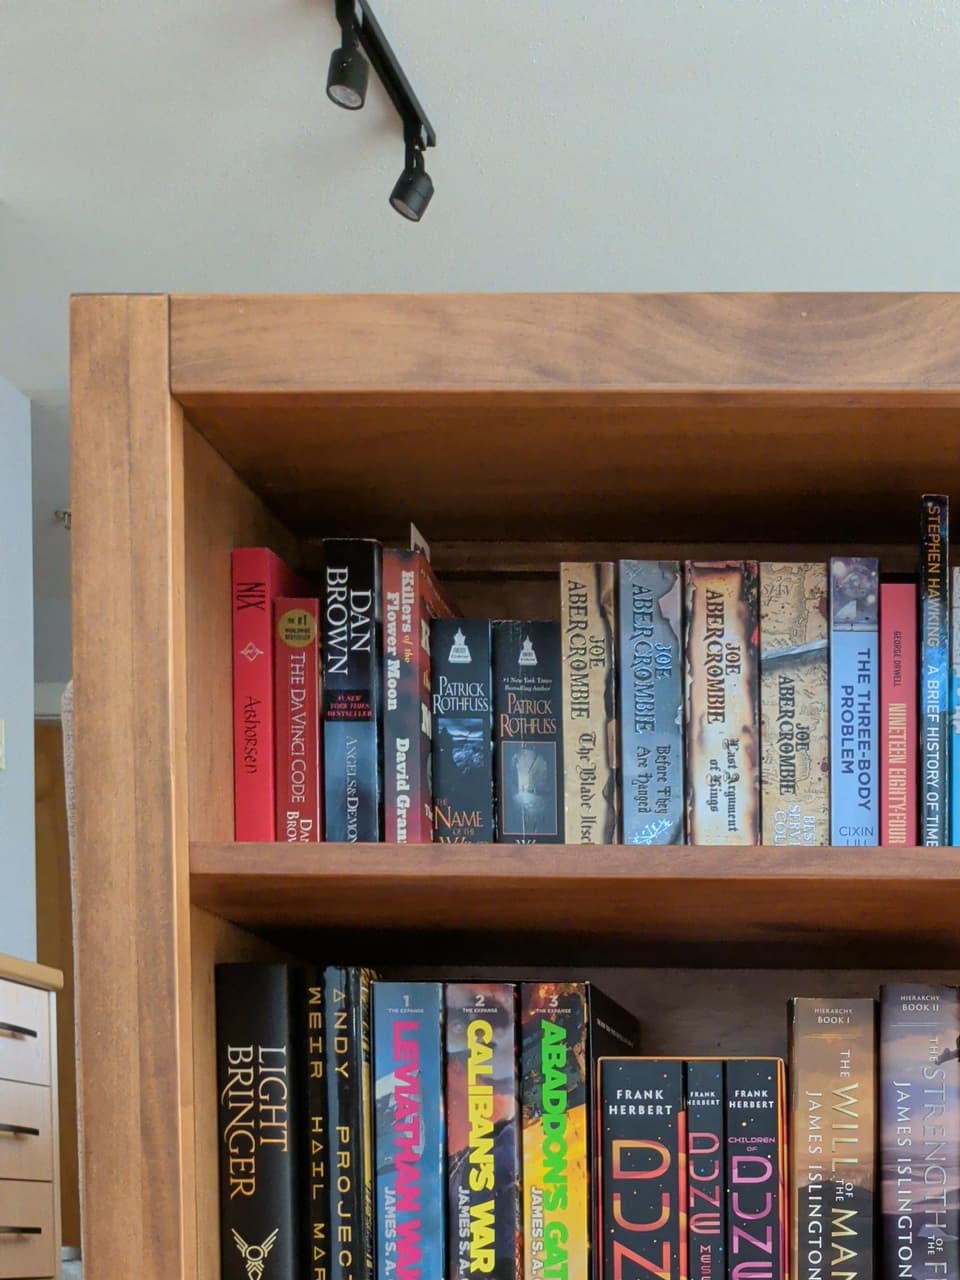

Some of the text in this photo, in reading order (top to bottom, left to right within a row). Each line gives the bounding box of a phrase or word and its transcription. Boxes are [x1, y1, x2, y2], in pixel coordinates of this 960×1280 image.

[237, 582, 266, 611] NIX
[326, 566, 349, 676] BROWN
[351, 589, 372, 652] DAN
[927, 506, 940, 647] STEPHEN HAWKING
[386, 592, 400, 710] Flower Moon
[433, 694, 489, 714] ROTHFUSS
[567, 580, 590, 720] ABERCROMBIE
[589, 636, 605, 670] JOE
[630, 583, 655, 733] ABERCROMBIE
[841, 685, 854, 774] PROBLEM
[857, 648, 871, 811] THE THREE-BODY
[888, 703, 907, 844] NINETEEN EIGHTY-FOUR
[926, 666, 939, 847] A BRIEF HISTORY OF TIME
[434, 806, 484, 830] NAME
[839, 826, 874, 837] CIXIN
[550, 996, 558, 1007] 3
[222, 1045, 256, 1199] BRINGER
[258, 1045, 288, 1152] LIGHT
[393, 1021, 422, 1212] LEVIATHAN
[467, 1019, 495, 1274] CALIBAN'S WAR
[541, 1019, 568, 1211] ABADDON'S
[608, 1105, 672, 1115] HERBERT
[616, 1090, 664, 1100] FRANK
[729, 1101, 774, 1109] HERBERT
[735, 1090, 769, 1098] FRANK
[832, 1049, 859, 1172] THE WILL
[806, 1091, 822, 1280] JAMES ISLINGTON
